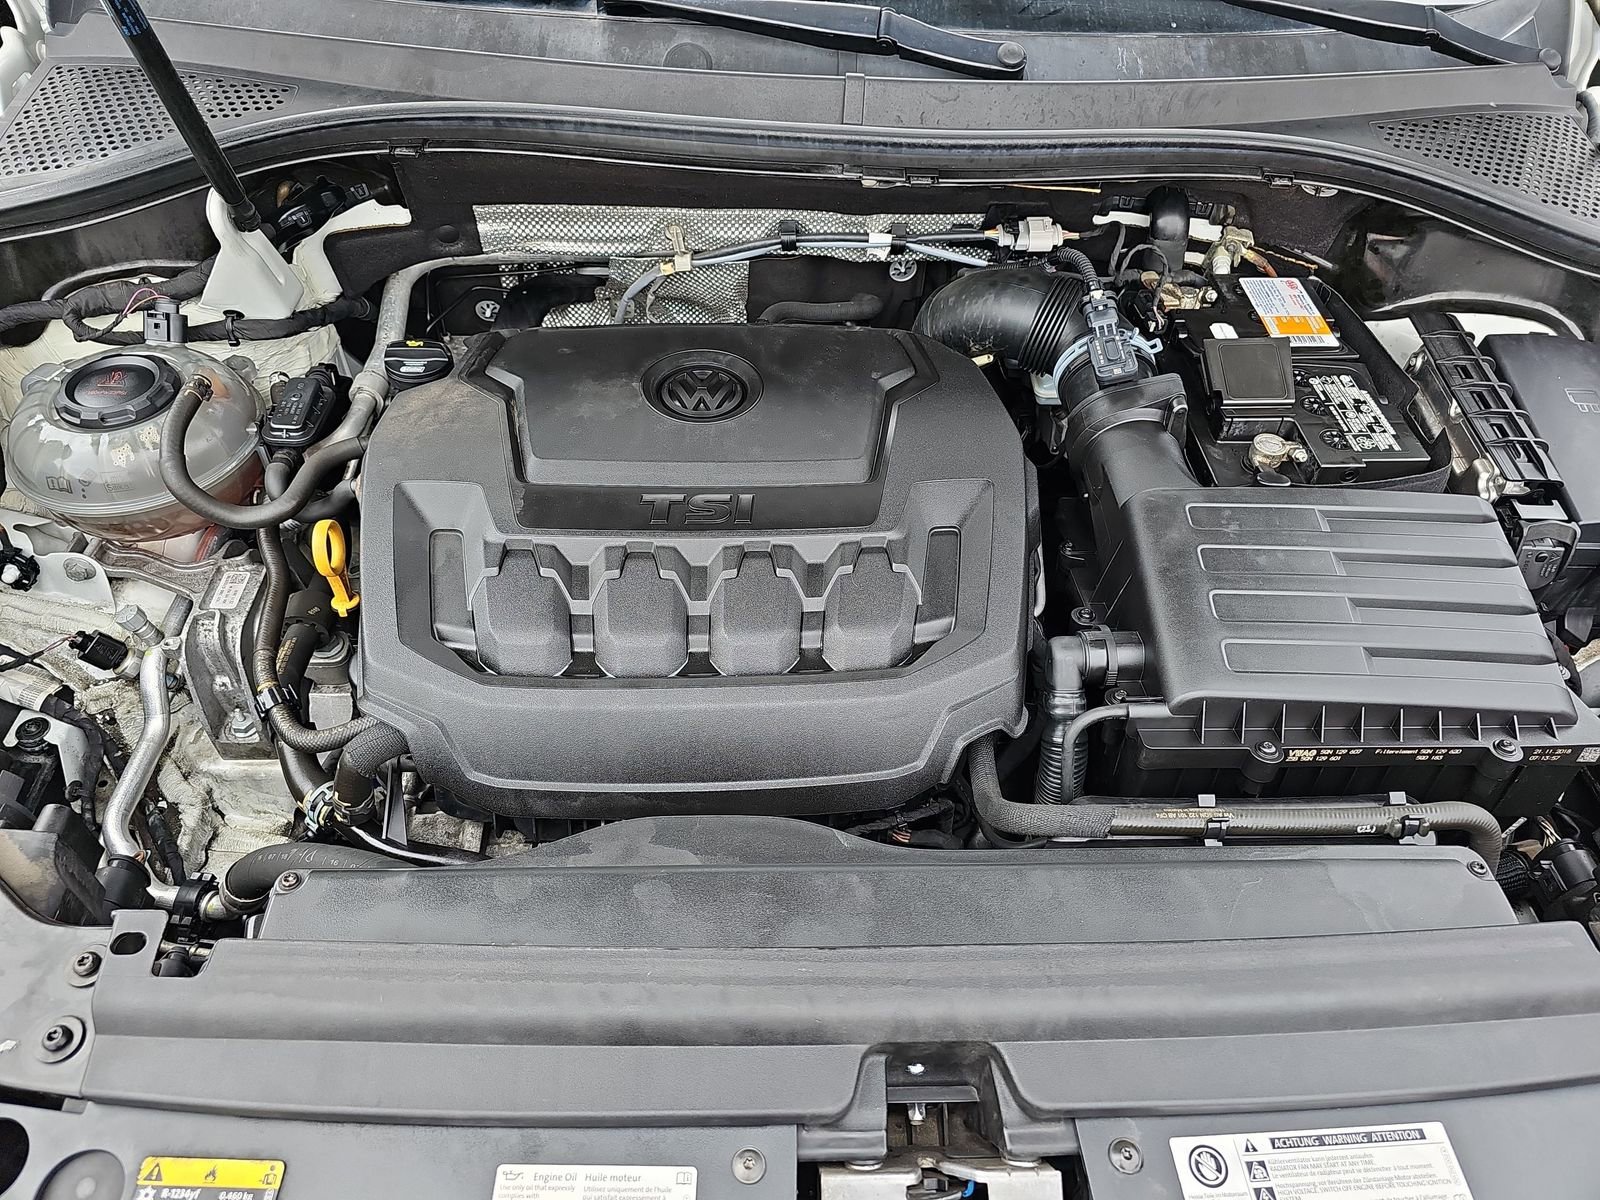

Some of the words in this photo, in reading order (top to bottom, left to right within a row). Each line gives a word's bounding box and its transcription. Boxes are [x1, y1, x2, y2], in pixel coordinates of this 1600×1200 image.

[660, 365, 744, 417] VW
[640, 493, 755, 525] TSI
[1274, 1136, 1320, 1148] ACHTUNG
[1322, 1132, 1368, 1145] WARNING
[1371, 1129, 1420, 1142] ATTENTION
[533, 1172, 563, 1184] Engine
[565, 1172, 578, 1182] Oil
[584, 1172, 608, 1182] Huile
[610, 1174, 642, 1182] moteur
